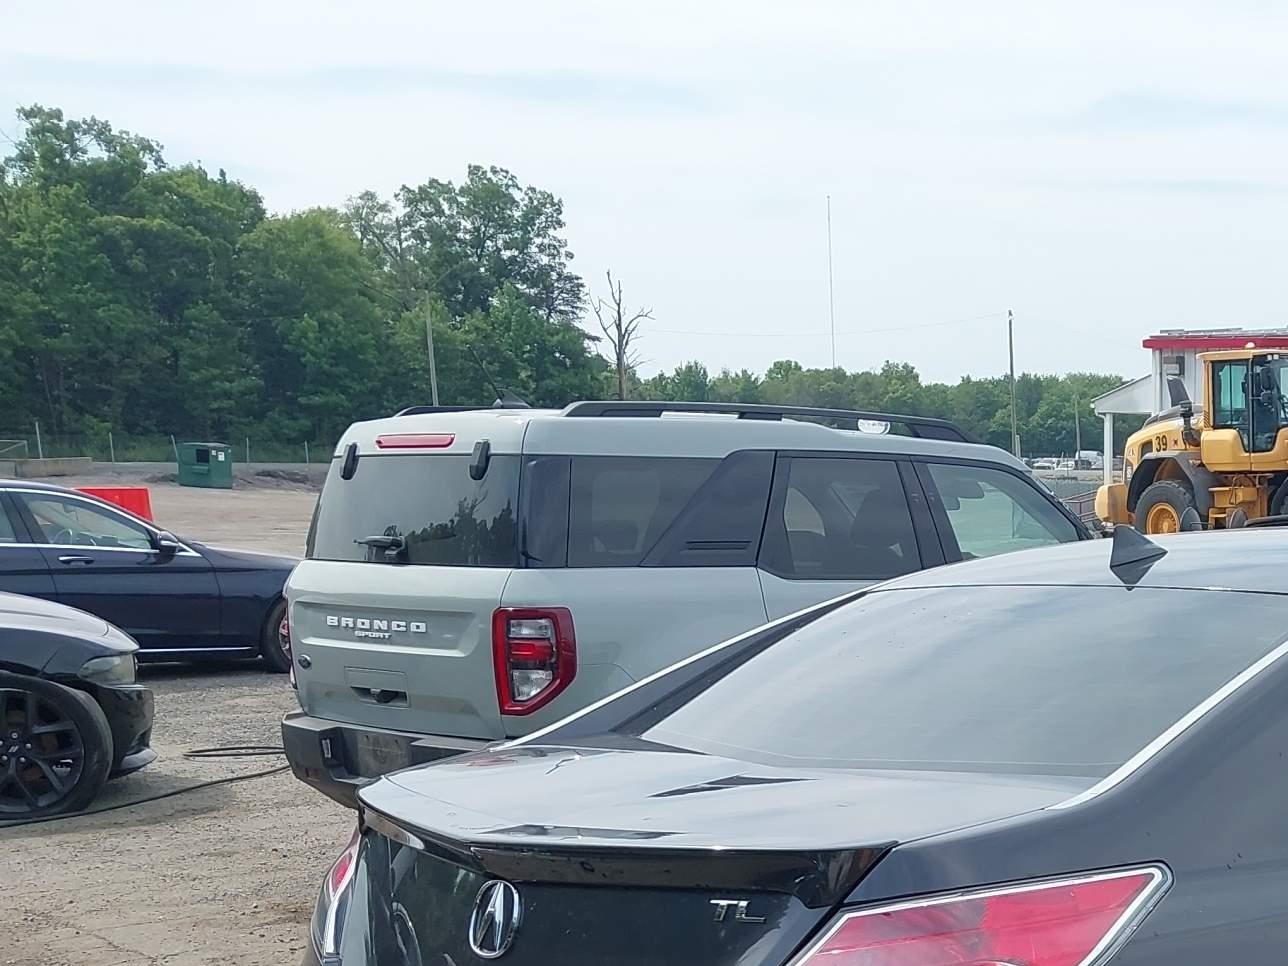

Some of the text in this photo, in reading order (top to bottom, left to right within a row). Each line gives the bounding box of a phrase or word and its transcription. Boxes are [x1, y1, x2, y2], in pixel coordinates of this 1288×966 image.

[1155, 435, 1168, 452] 39
[326, 615, 428, 633] BRONCO
[354, 630, 392, 639] SPORT
[709, 899, 766, 923] TL
